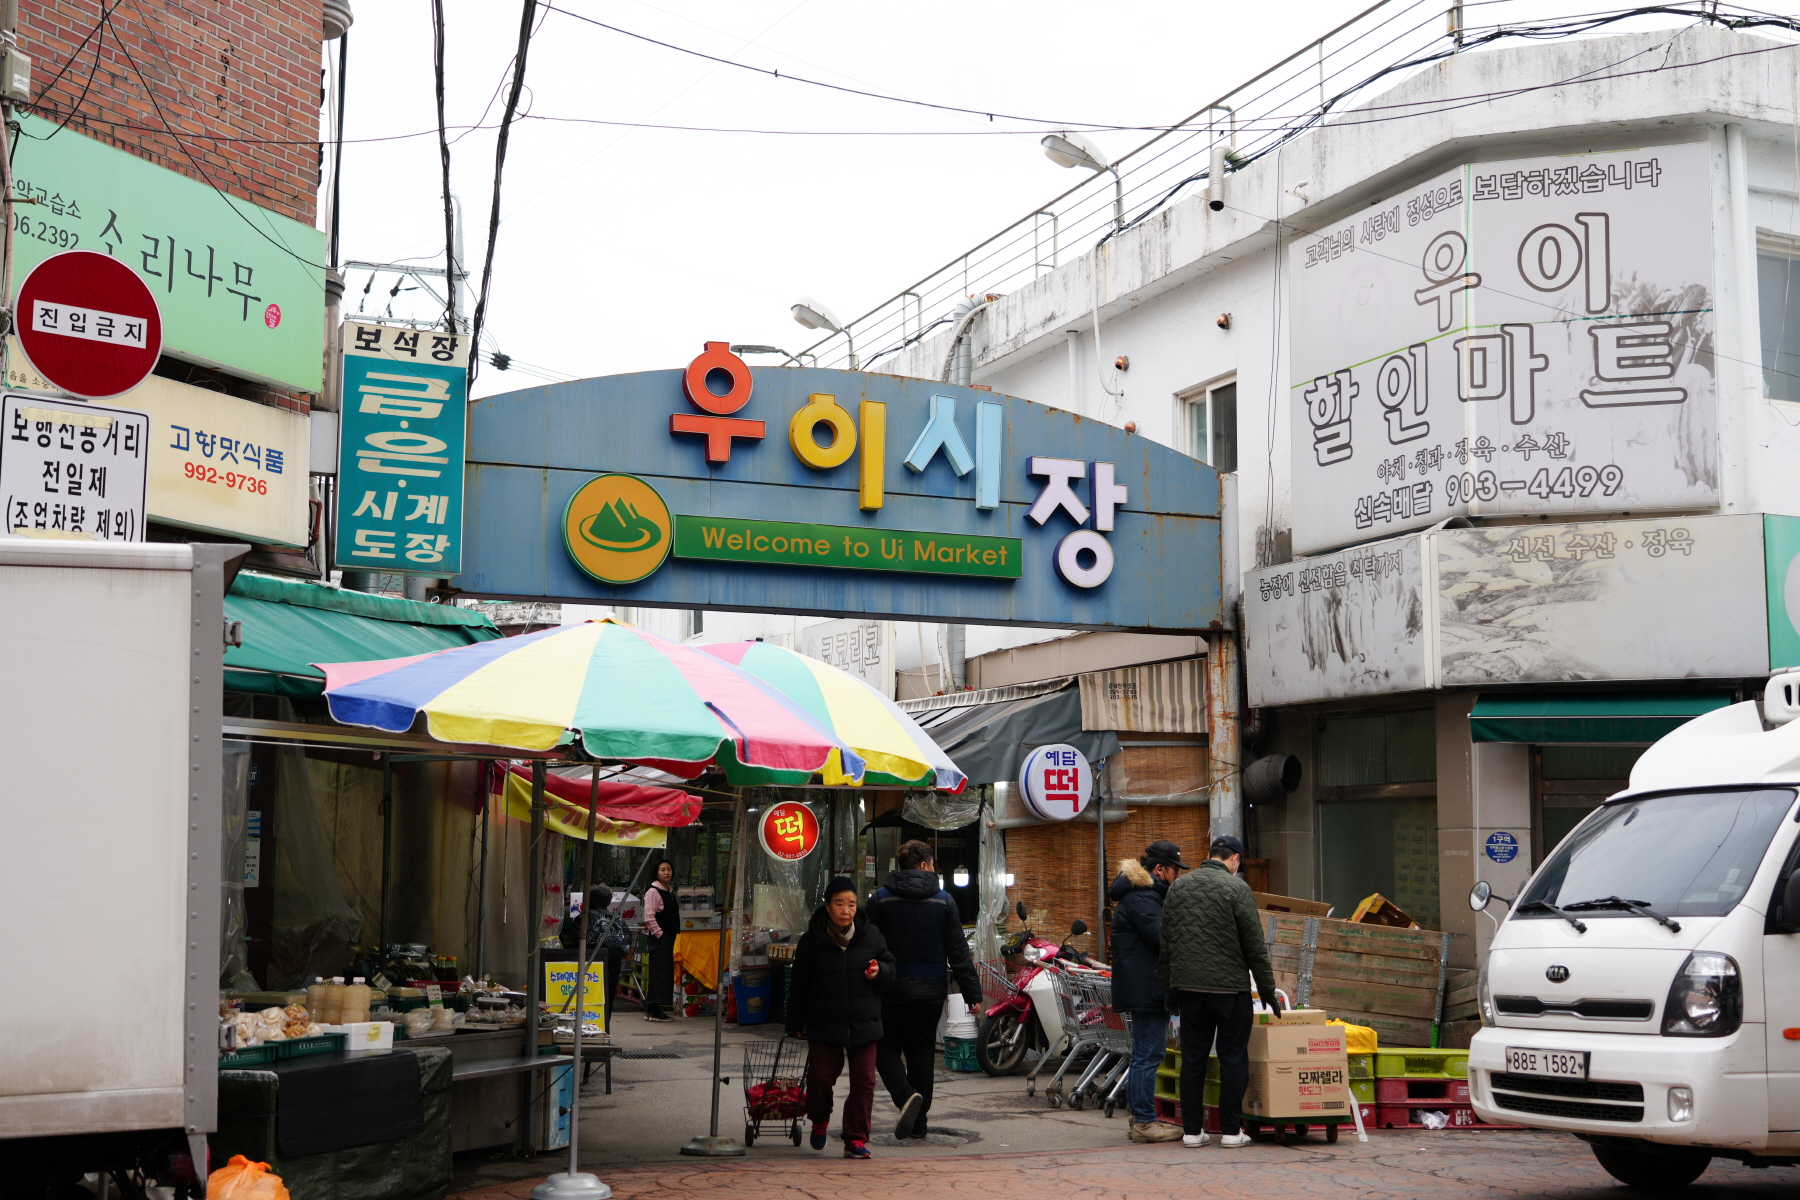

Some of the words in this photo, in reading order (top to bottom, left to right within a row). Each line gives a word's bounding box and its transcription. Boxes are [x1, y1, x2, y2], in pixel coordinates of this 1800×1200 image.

[11, 178, 82, 219] 악교습소
[1305, 226, 1355, 269] 고객님의
[1360, 205, 1400, 245] 사랑에
[1406, 179, 1464, 226] 정성으로
[1473, 158, 1661, 200] 보답하겠습니다
[1414, 212, 1610, 331] 우이
[39, 307, 142, 342] 진입금지
[354, 326, 459, 362] 보석장
[1304, 321, 1688, 467] 할인마트
[170, 424, 284, 474] 고향맛식품
[669, 341, 1128, 589] 우이시장
[42, 461, 107, 498] 전일제
[184, 462, 268, 495] 992-9736
[1355, 481, 1433, 530] 신속배달
[1446, 465, 1624, 506] 903-4499
[96, 508, 135, 542] 제외)
[351, 528, 451, 563] 도장
[702, 526, 831, 556] Welcome
[843, 535, 869, 558] to
[881, 538, 904, 560] Ui
[914, 540, 1008, 566] Market
[1507, 534, 1556, 563] 신선
[1260, 572, 1294, 601] 농장에
[1298, 561, 1347, 593] 신선함을
[1351, 549, 1403, 583] 식탁까지
[822, 624, 880, 675] 코코리코
[1045, 751, 1077, 766] 예담
[1044, 768, 1079, 812] 떡
[774, 810, 804, 850] 떡
[1547, 967, 1566, 979] KIA
[1298, 1070, 1344, 1085] 모짜렐라
[1513, 1051, 1537, 1071] 88모
[1543, 1054, 1577, 1074] 1582
[1298, 1086, 1323, 1096] 핫도그
